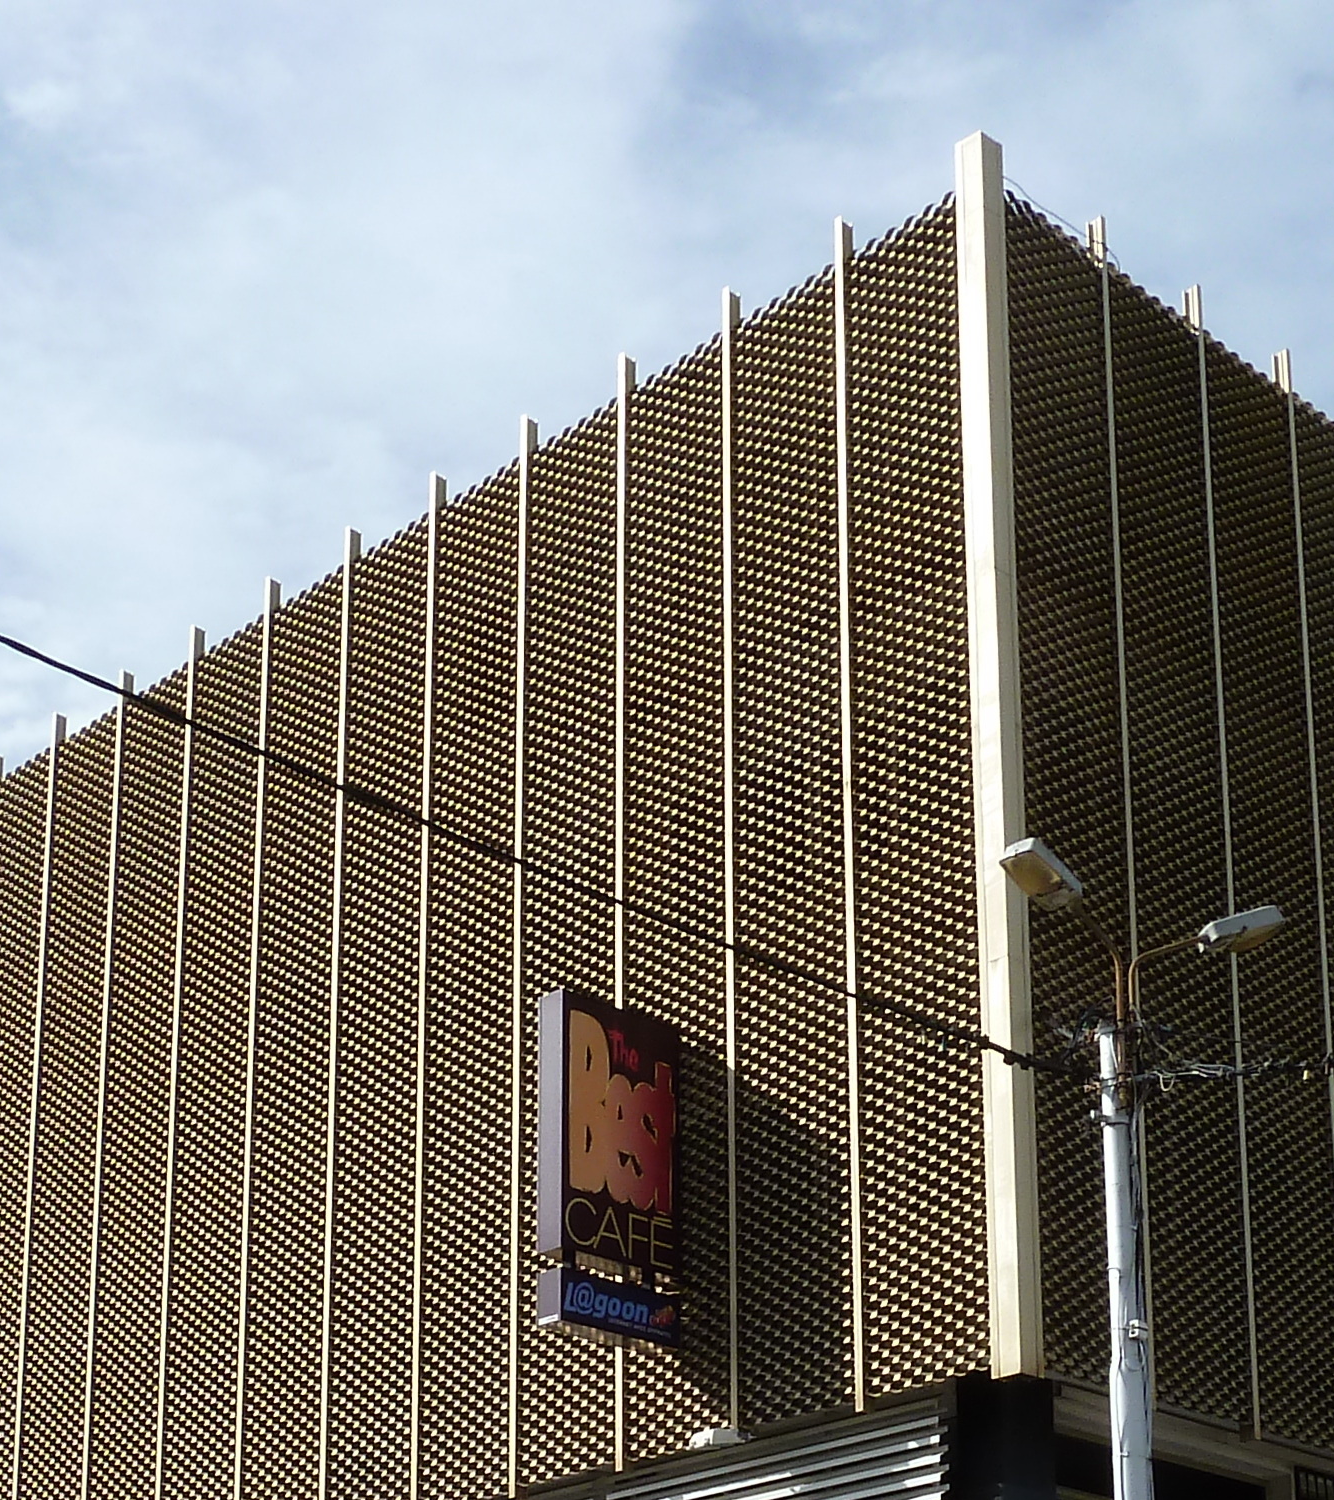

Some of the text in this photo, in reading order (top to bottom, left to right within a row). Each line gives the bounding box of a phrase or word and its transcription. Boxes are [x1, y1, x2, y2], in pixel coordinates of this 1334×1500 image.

[608, 1028, 640, 1072] The
[568, 1008, 675, 1217] Best
[565, 1197, 673, 1270] CAFÉ
[564, 1281, 650, 1327] L@goon
